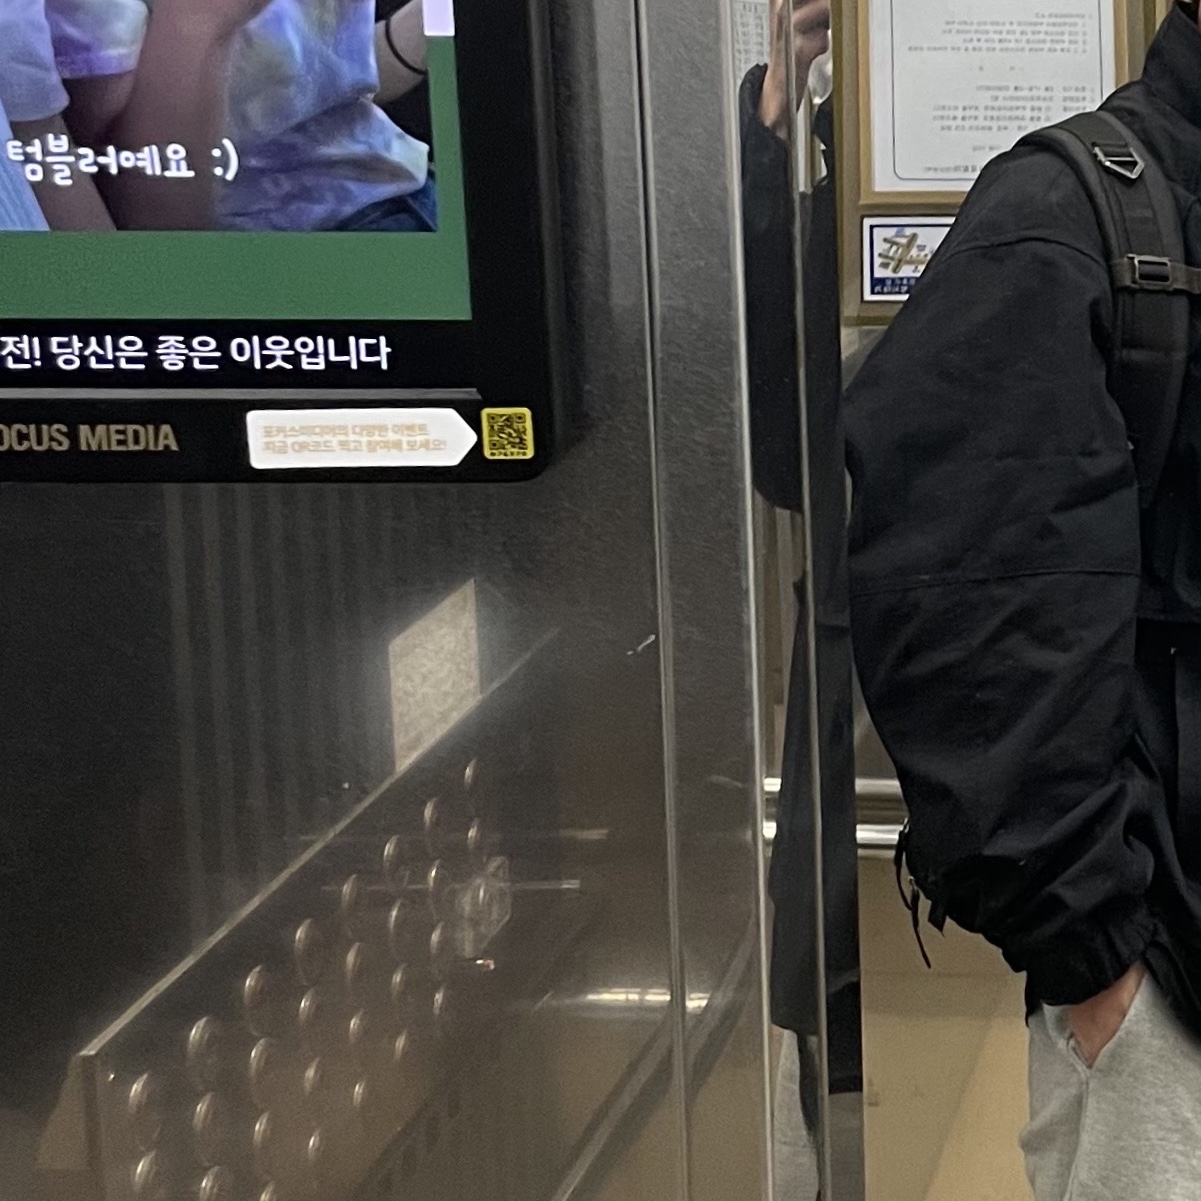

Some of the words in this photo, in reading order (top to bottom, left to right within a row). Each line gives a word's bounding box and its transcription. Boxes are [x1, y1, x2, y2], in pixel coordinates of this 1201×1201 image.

[7, 133, 195, 186] 텀블러예요
[0, 334, 42, 370] 전!
[51, 335, 148, 370] 당신은
[156, 335, 222, 370] 좋은
[231, 335, 392, 370] 이웃입니다
[79, 424, 180, 451] MEDIA
